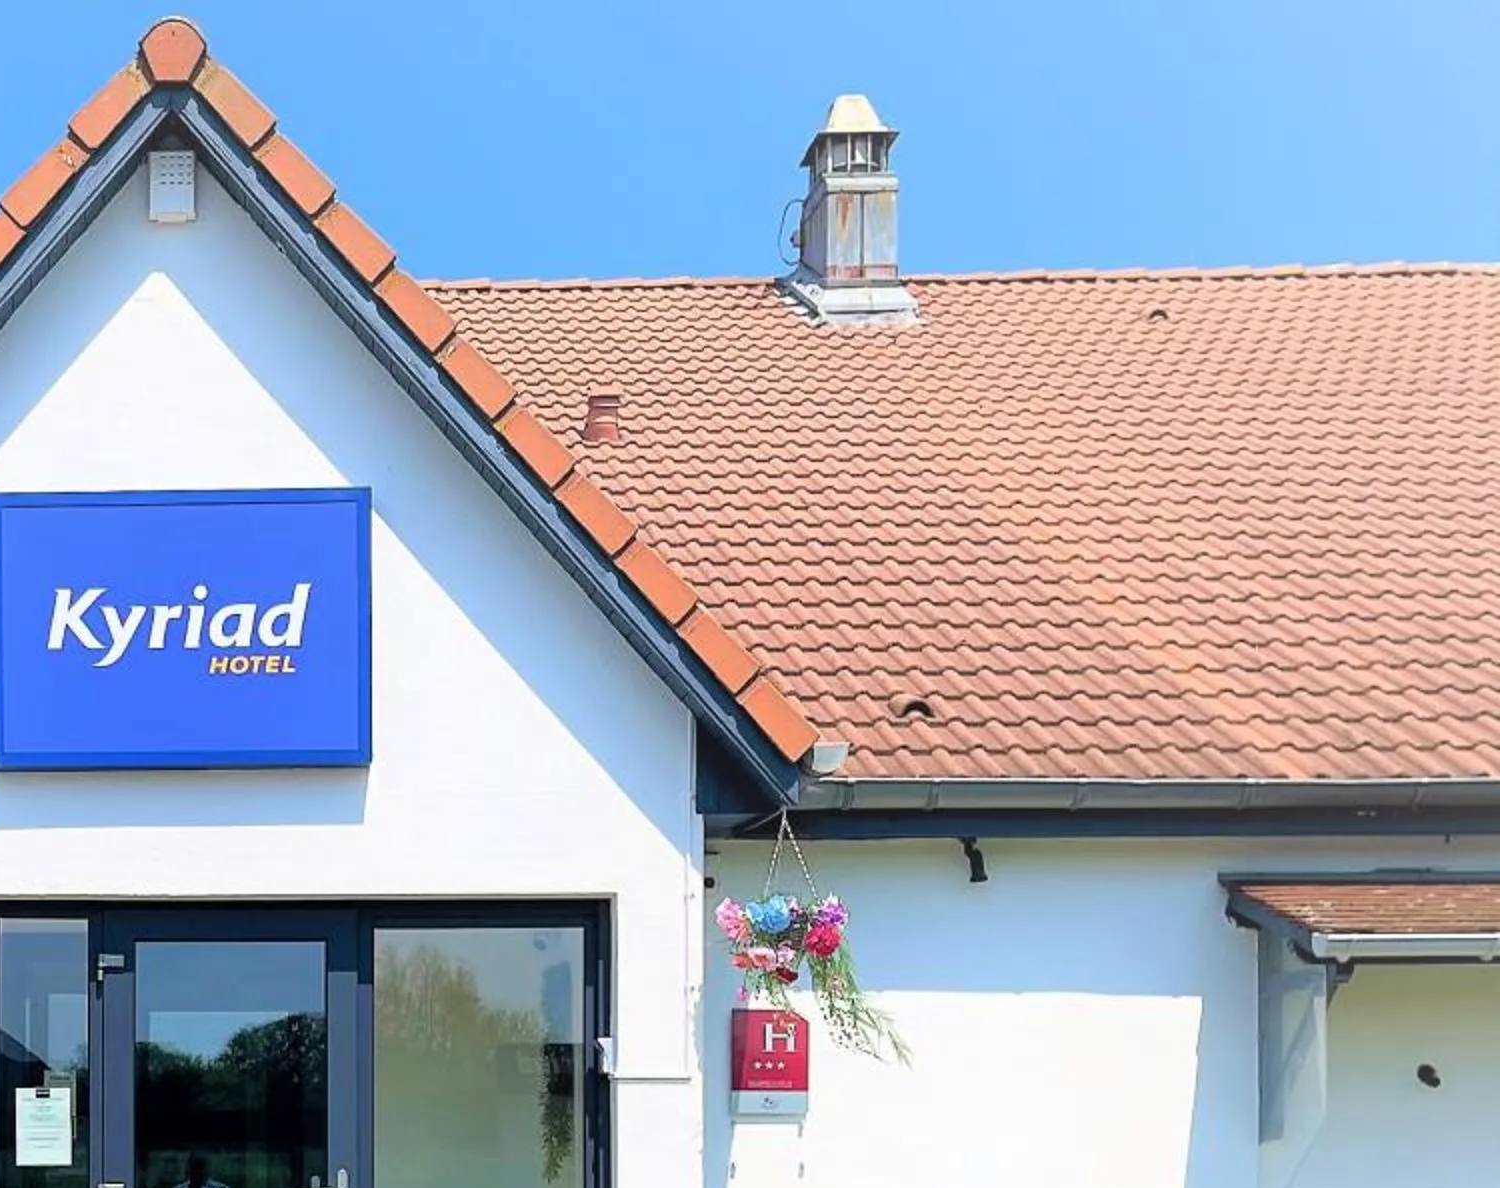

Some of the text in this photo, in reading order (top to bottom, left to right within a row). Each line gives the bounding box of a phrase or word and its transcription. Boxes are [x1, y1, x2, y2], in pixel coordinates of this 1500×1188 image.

[47, 582, 312, 668] Kyriad
[209, 655, 296, 674] HOTEL
[762, 1022, 797, 1053] H
